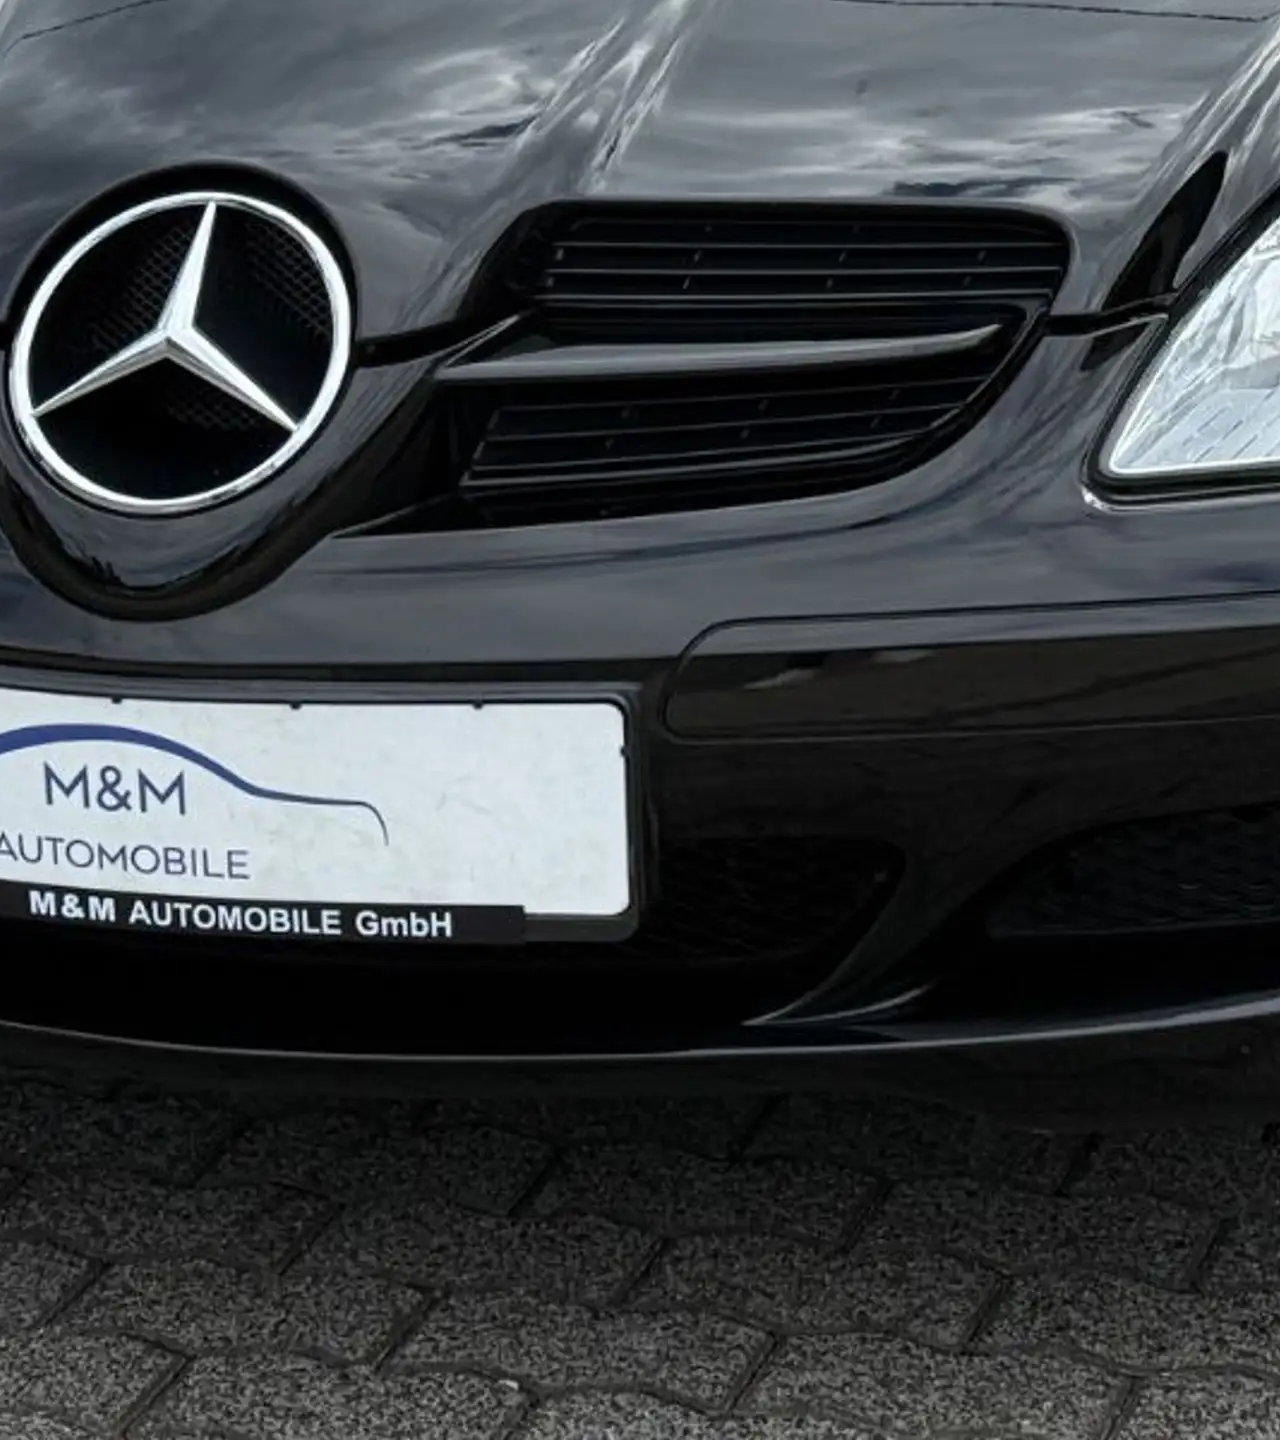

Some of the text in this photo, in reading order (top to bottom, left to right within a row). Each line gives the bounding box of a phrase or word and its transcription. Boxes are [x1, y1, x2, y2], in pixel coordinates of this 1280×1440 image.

[43, 761, 187, 816] M&M
[28, 890, 117, 922] M&M
[129, 899, 342, 936] AUTOMOBILE
[355, 910, 453, 938] GmbH
